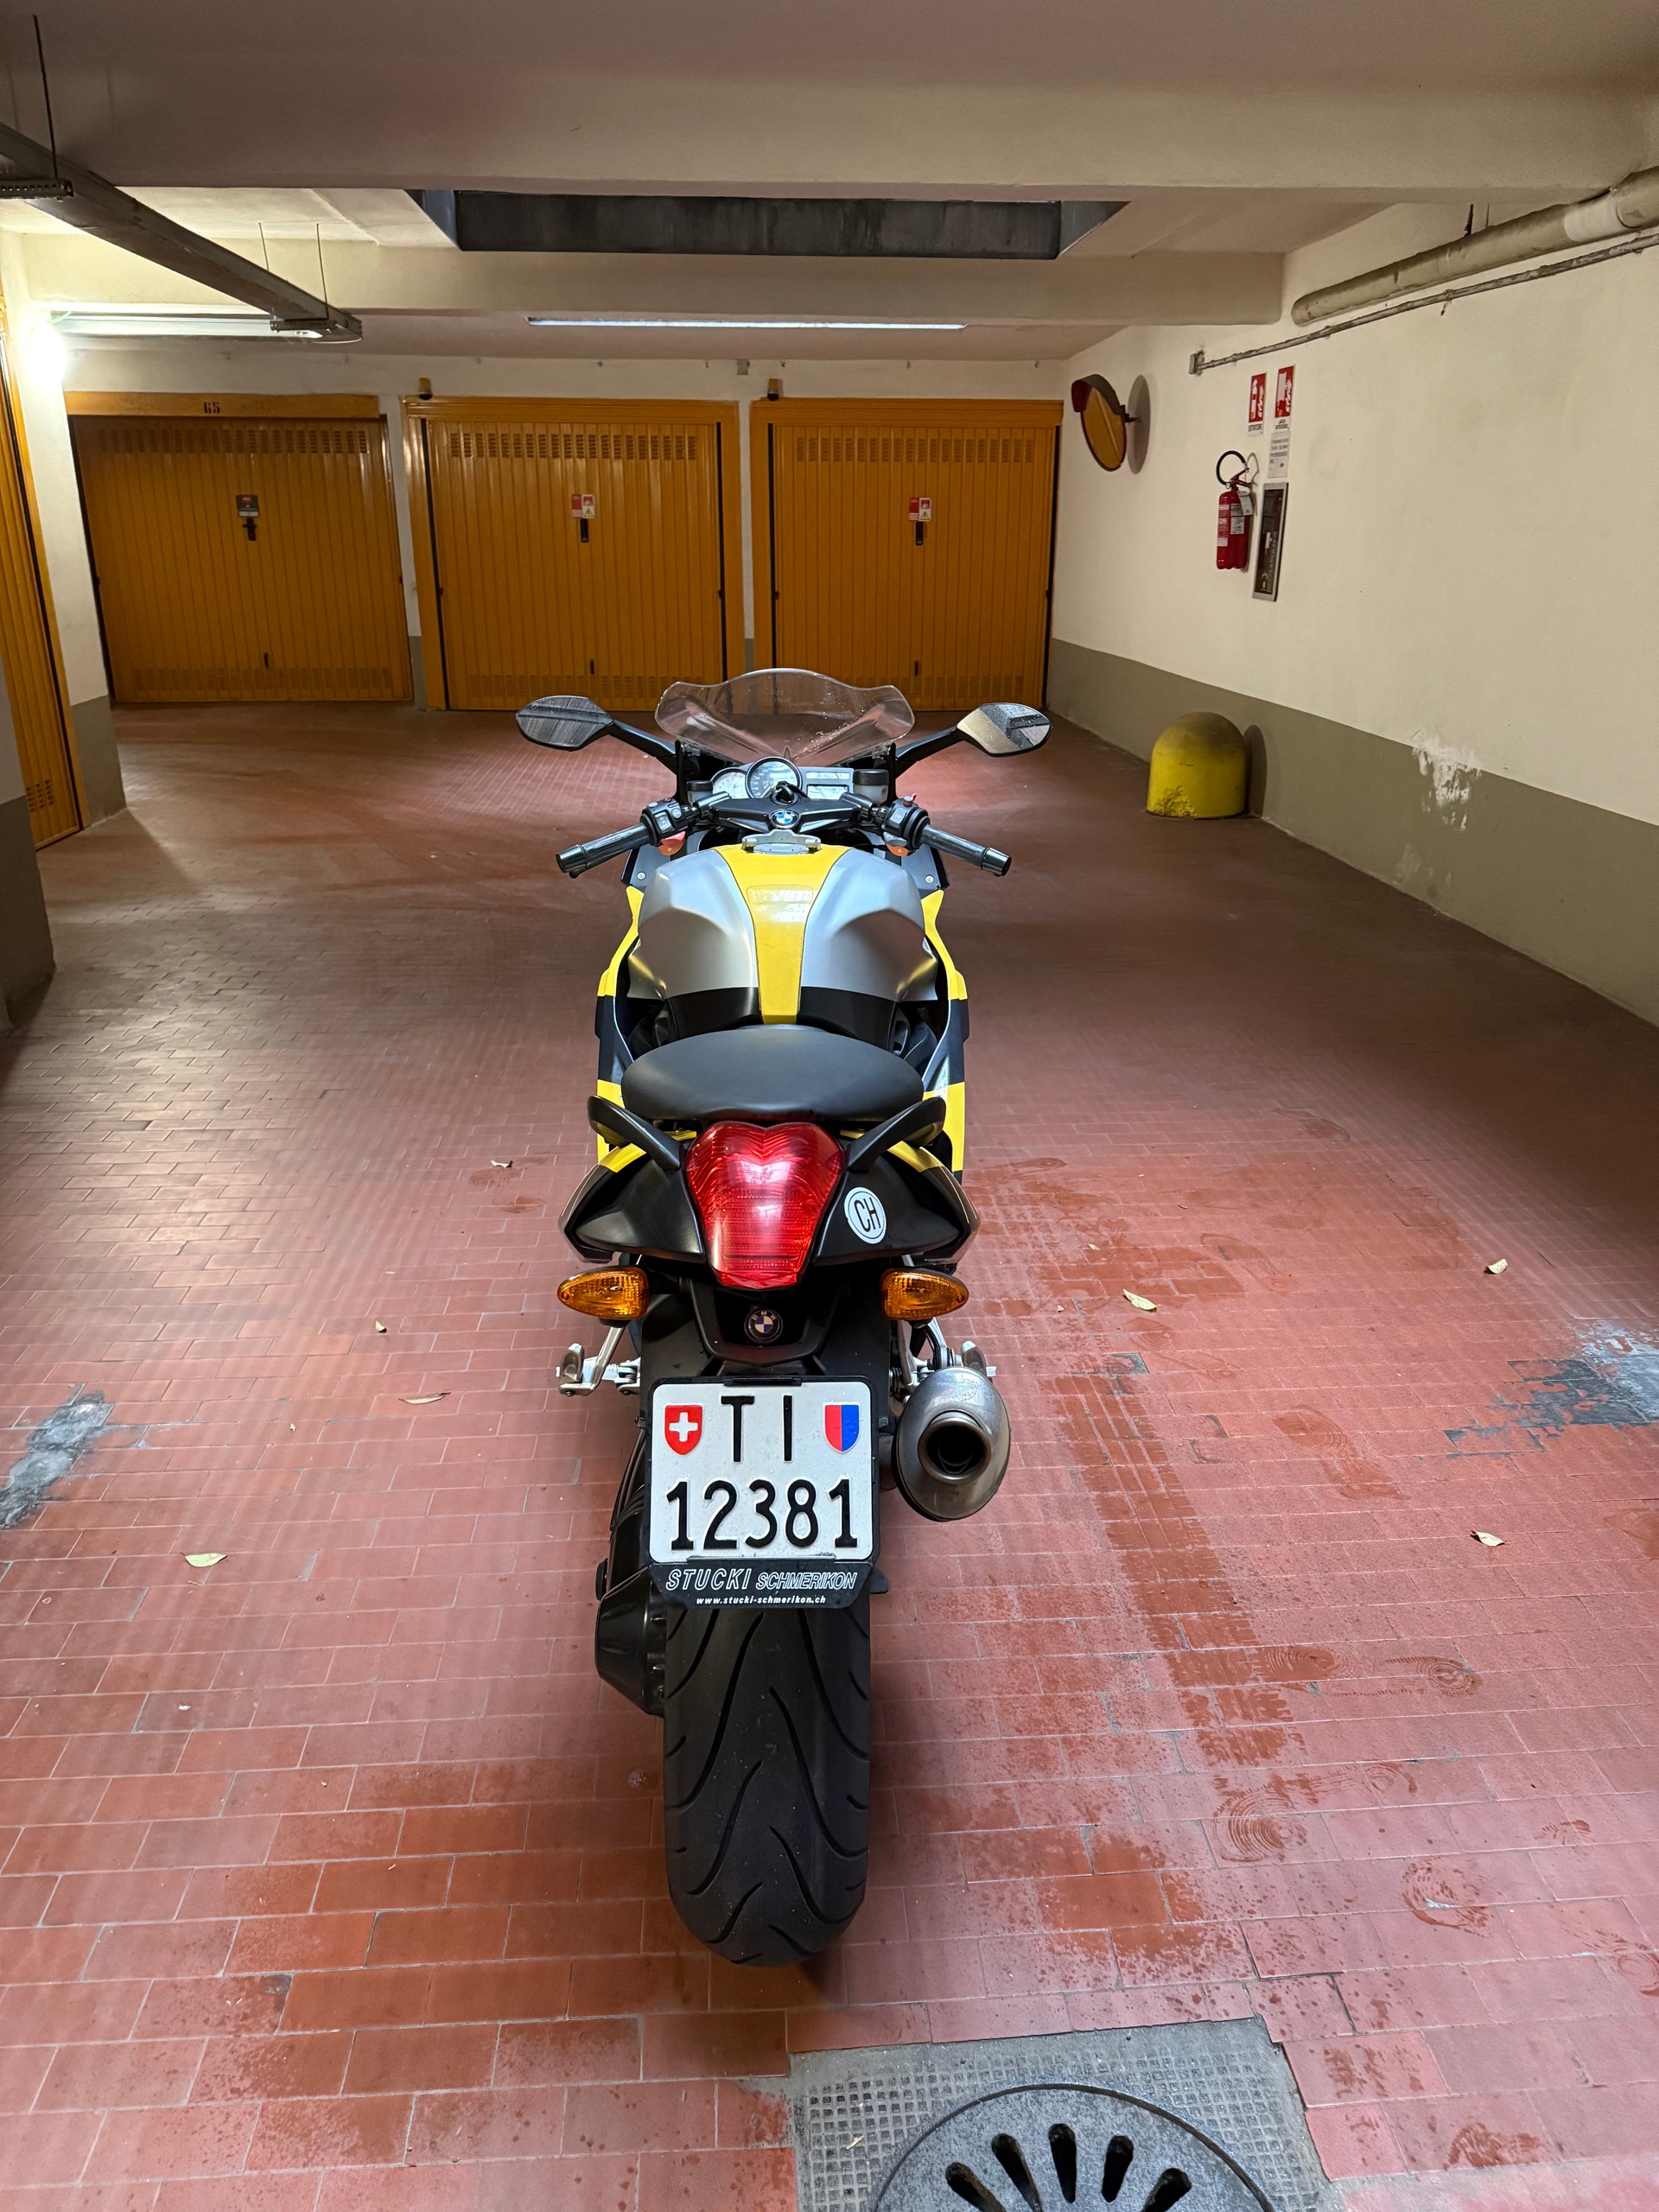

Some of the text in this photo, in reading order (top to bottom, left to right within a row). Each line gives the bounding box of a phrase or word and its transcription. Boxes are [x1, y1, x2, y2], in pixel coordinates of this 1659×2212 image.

[204, 402, 220, 414] 65
[854, 1197, 881, 1233] CH
[752, 1311, 777, 1321] BMW
[666, 1478, 858, 1550] 12381
[665, 1568, 858, 1591] STUCKI SCHMERIKON
[696, 1595, 826, 1605] www.stucki-schmerikon.ch
